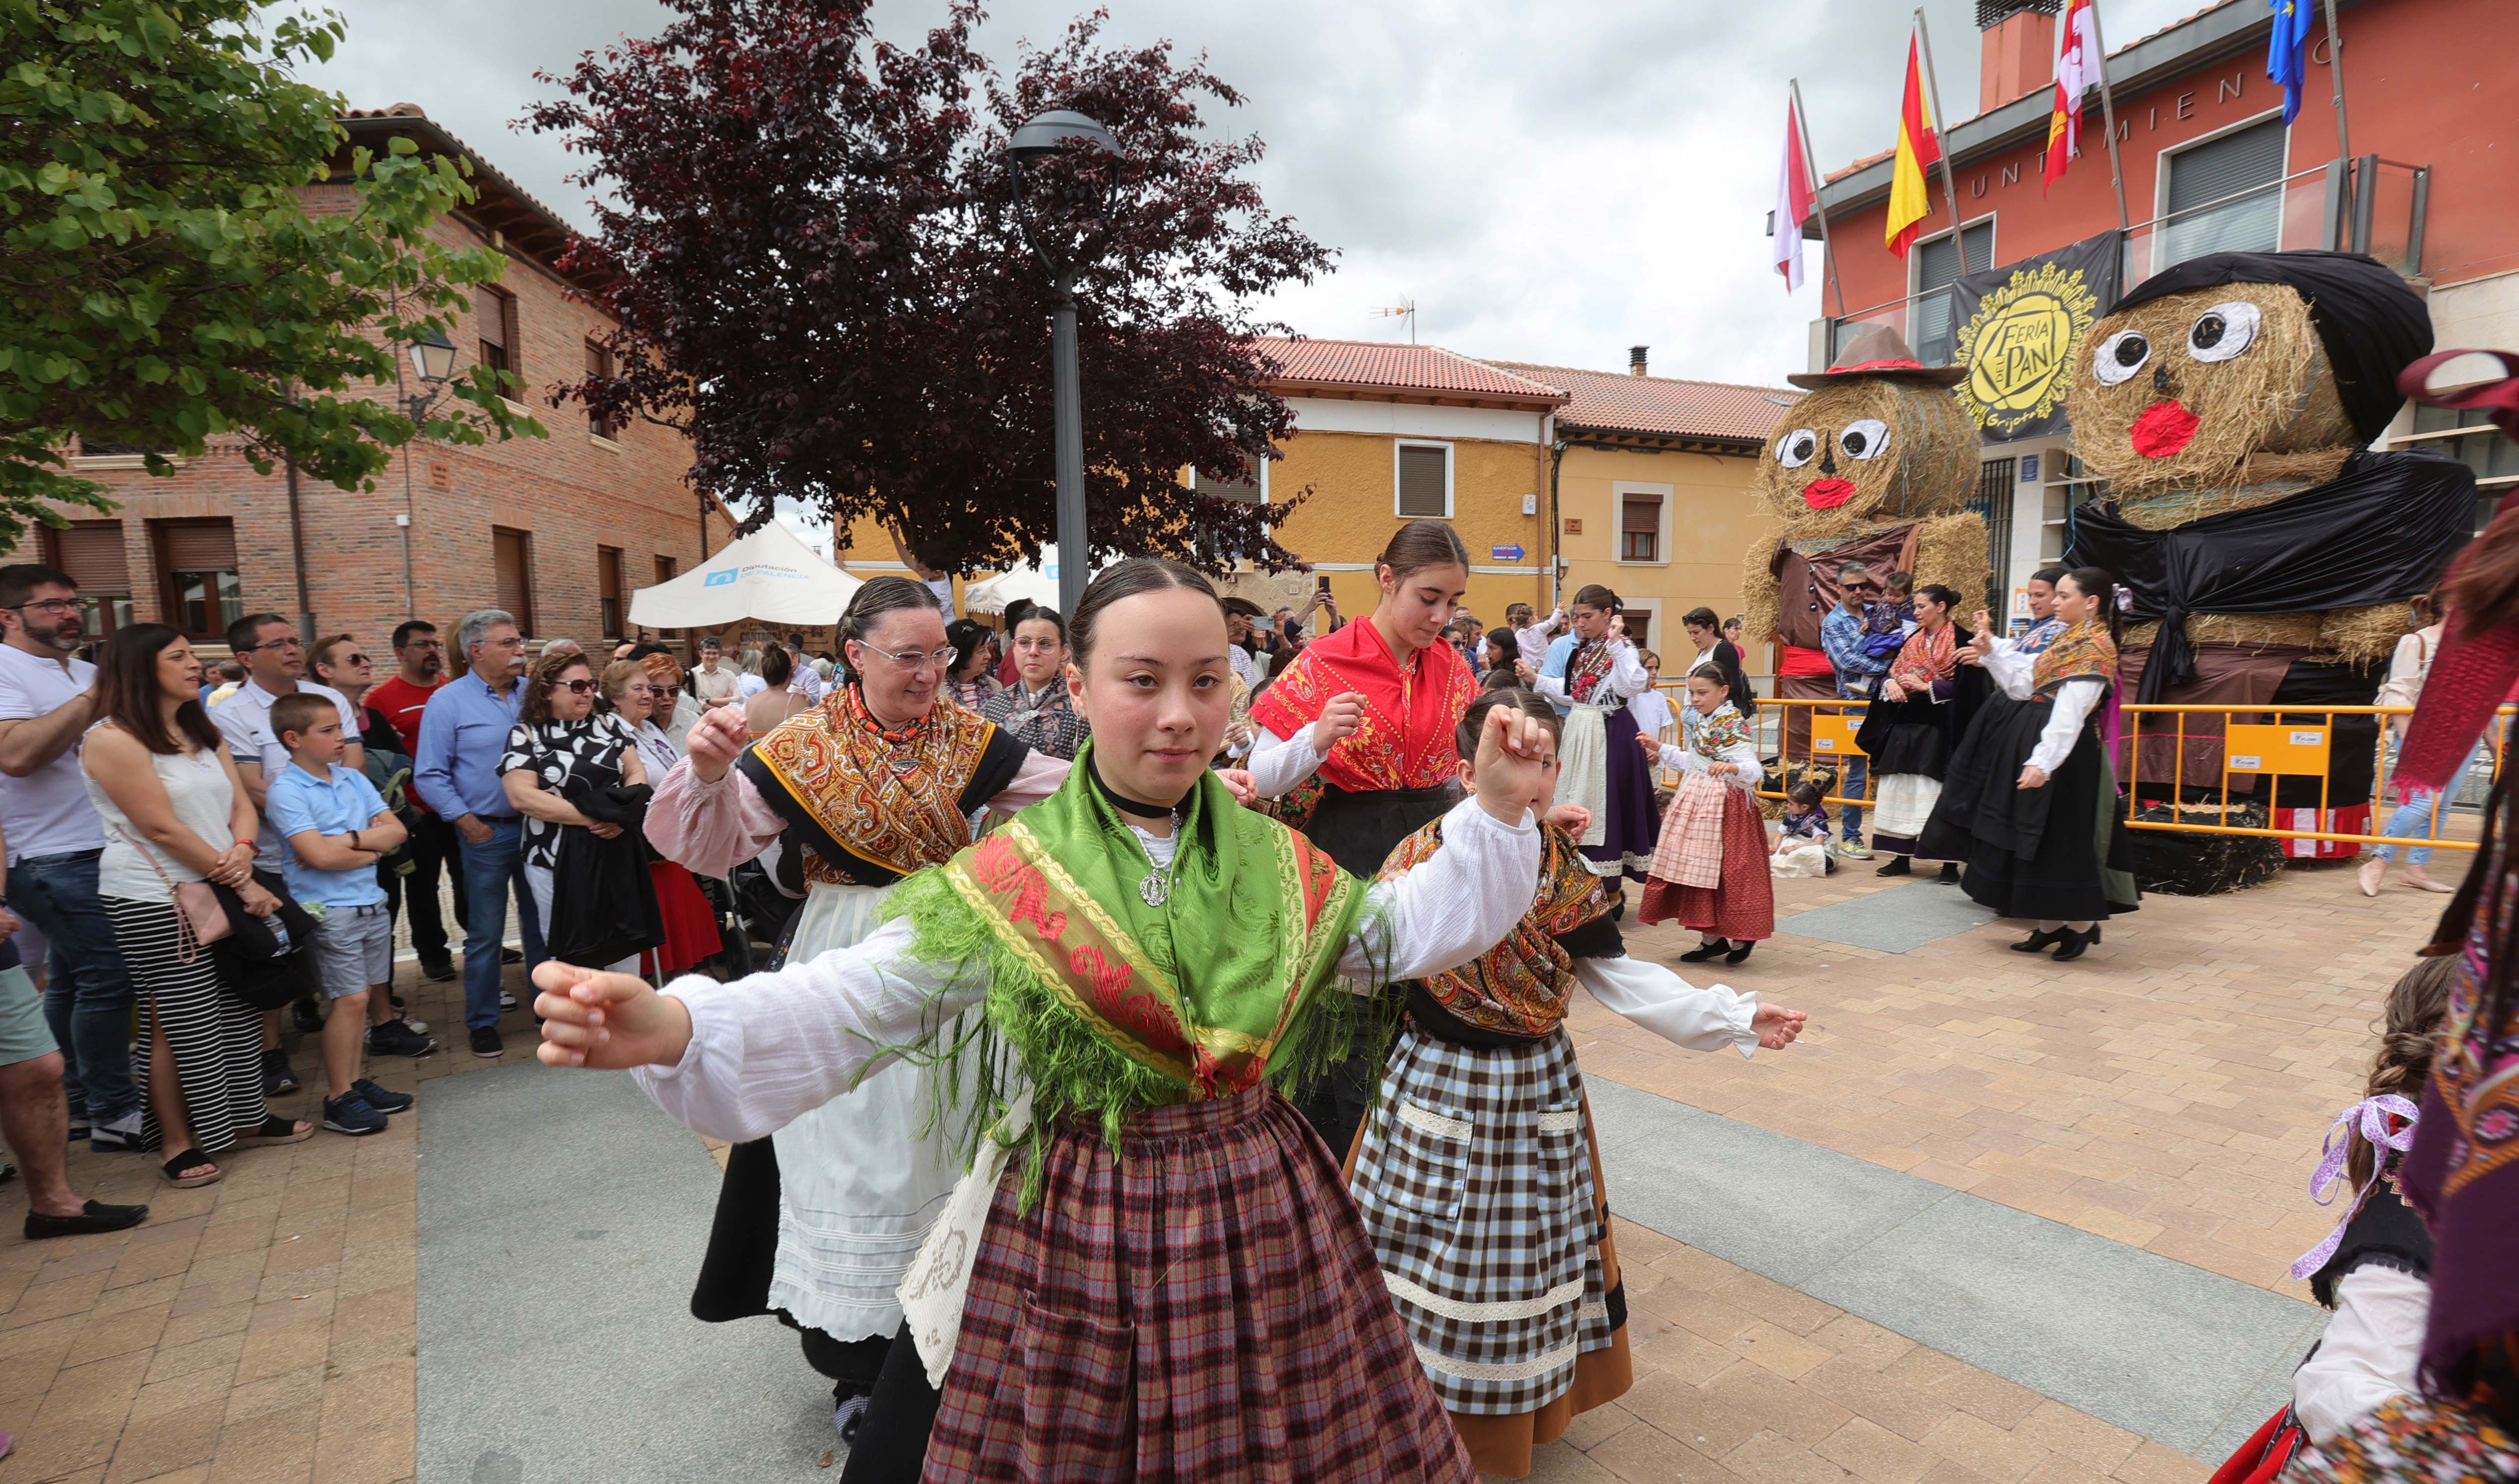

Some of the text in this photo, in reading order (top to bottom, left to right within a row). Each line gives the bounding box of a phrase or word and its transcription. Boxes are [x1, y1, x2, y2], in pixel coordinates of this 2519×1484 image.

[1994, 319, 2049, 358] FERIA
[1995, 356, 2005, 383] DEL
[2001, 342, 2049, 391] PAN
[1986, 410, 2037, 433] Grijota
[740, 570, 810, 579] DE PALENCIA
[741, 563, 798, 573] Diputación
